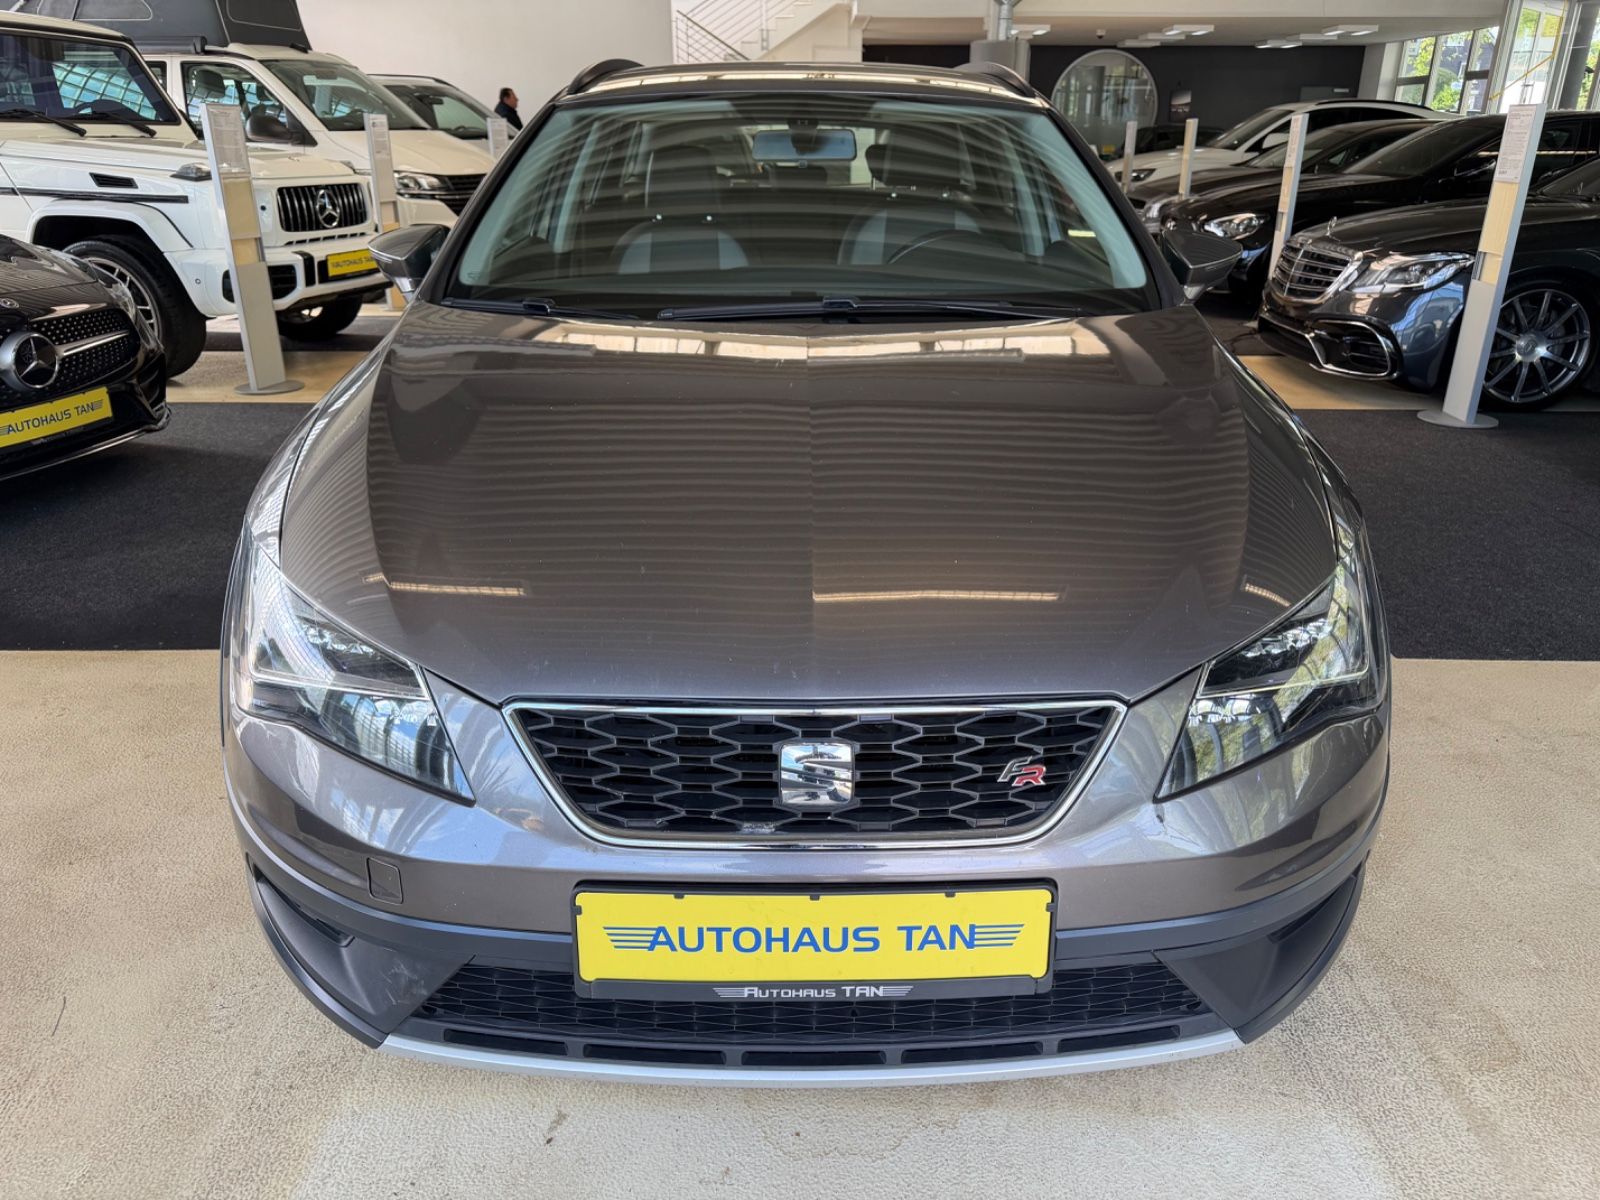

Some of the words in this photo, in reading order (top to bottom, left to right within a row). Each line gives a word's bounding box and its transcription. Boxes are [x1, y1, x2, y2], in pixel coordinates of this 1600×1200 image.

[7, 409, 72, 435] AUTOHAUS
[74, 402, 95, 416] TAN
[997, 756, 1046, 787] FR
[648, 926, 880, 953] AUTOHAUS
[897, 924, 976, 951] TAN
[841, 986, 884, 997] TAN
